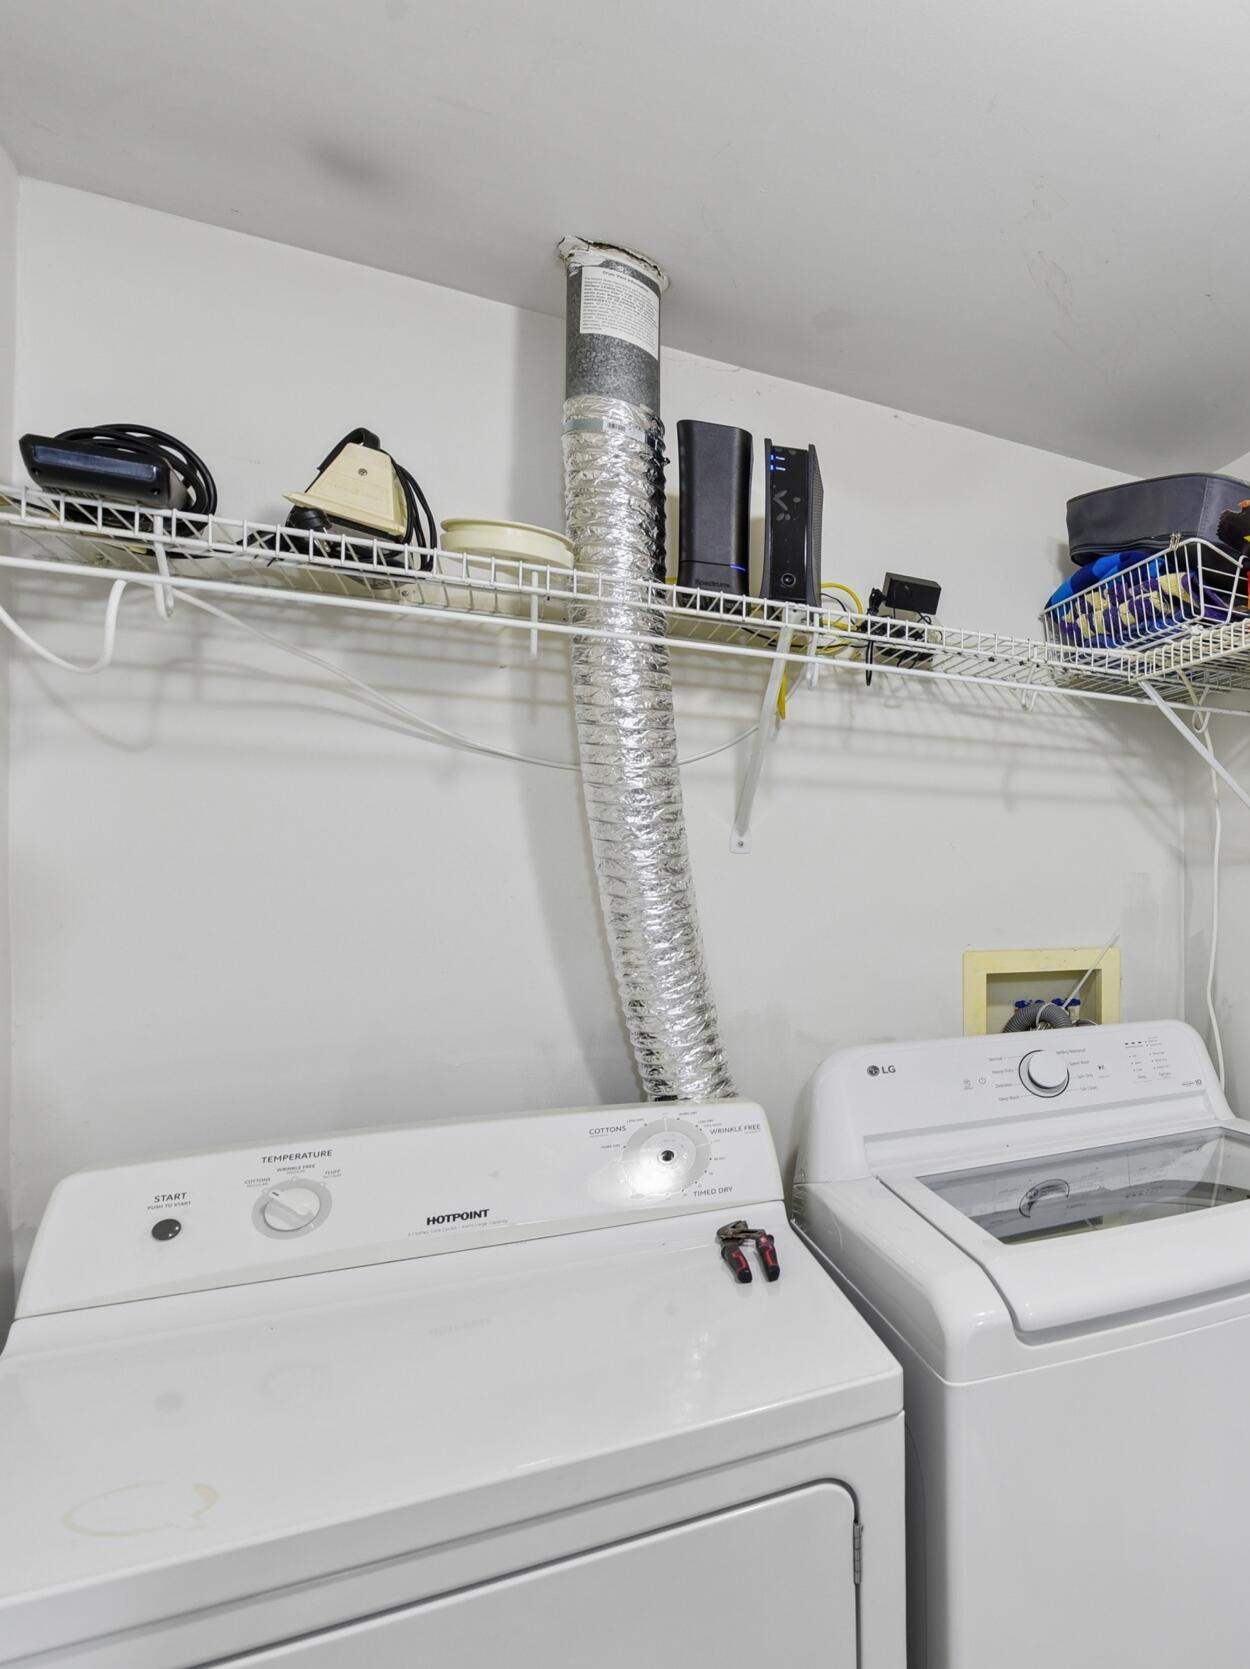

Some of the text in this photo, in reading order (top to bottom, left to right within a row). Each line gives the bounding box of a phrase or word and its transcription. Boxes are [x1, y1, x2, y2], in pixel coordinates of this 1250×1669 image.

[881, 1065, 896, 1074] LG
[588, 1125, 627, 1136] COTTONS
[710, 1125, 742, 1135] WRINKLE
[743, 1123, 761, 1131] FREE
[261, 1149, 333, 1164] TEMPERATURE
[154, 1192, 187, 1203] START
[693, 1186, 733, 1198] TIMED DRY
[426, 1208, 490, 1226] HOTPOINT
